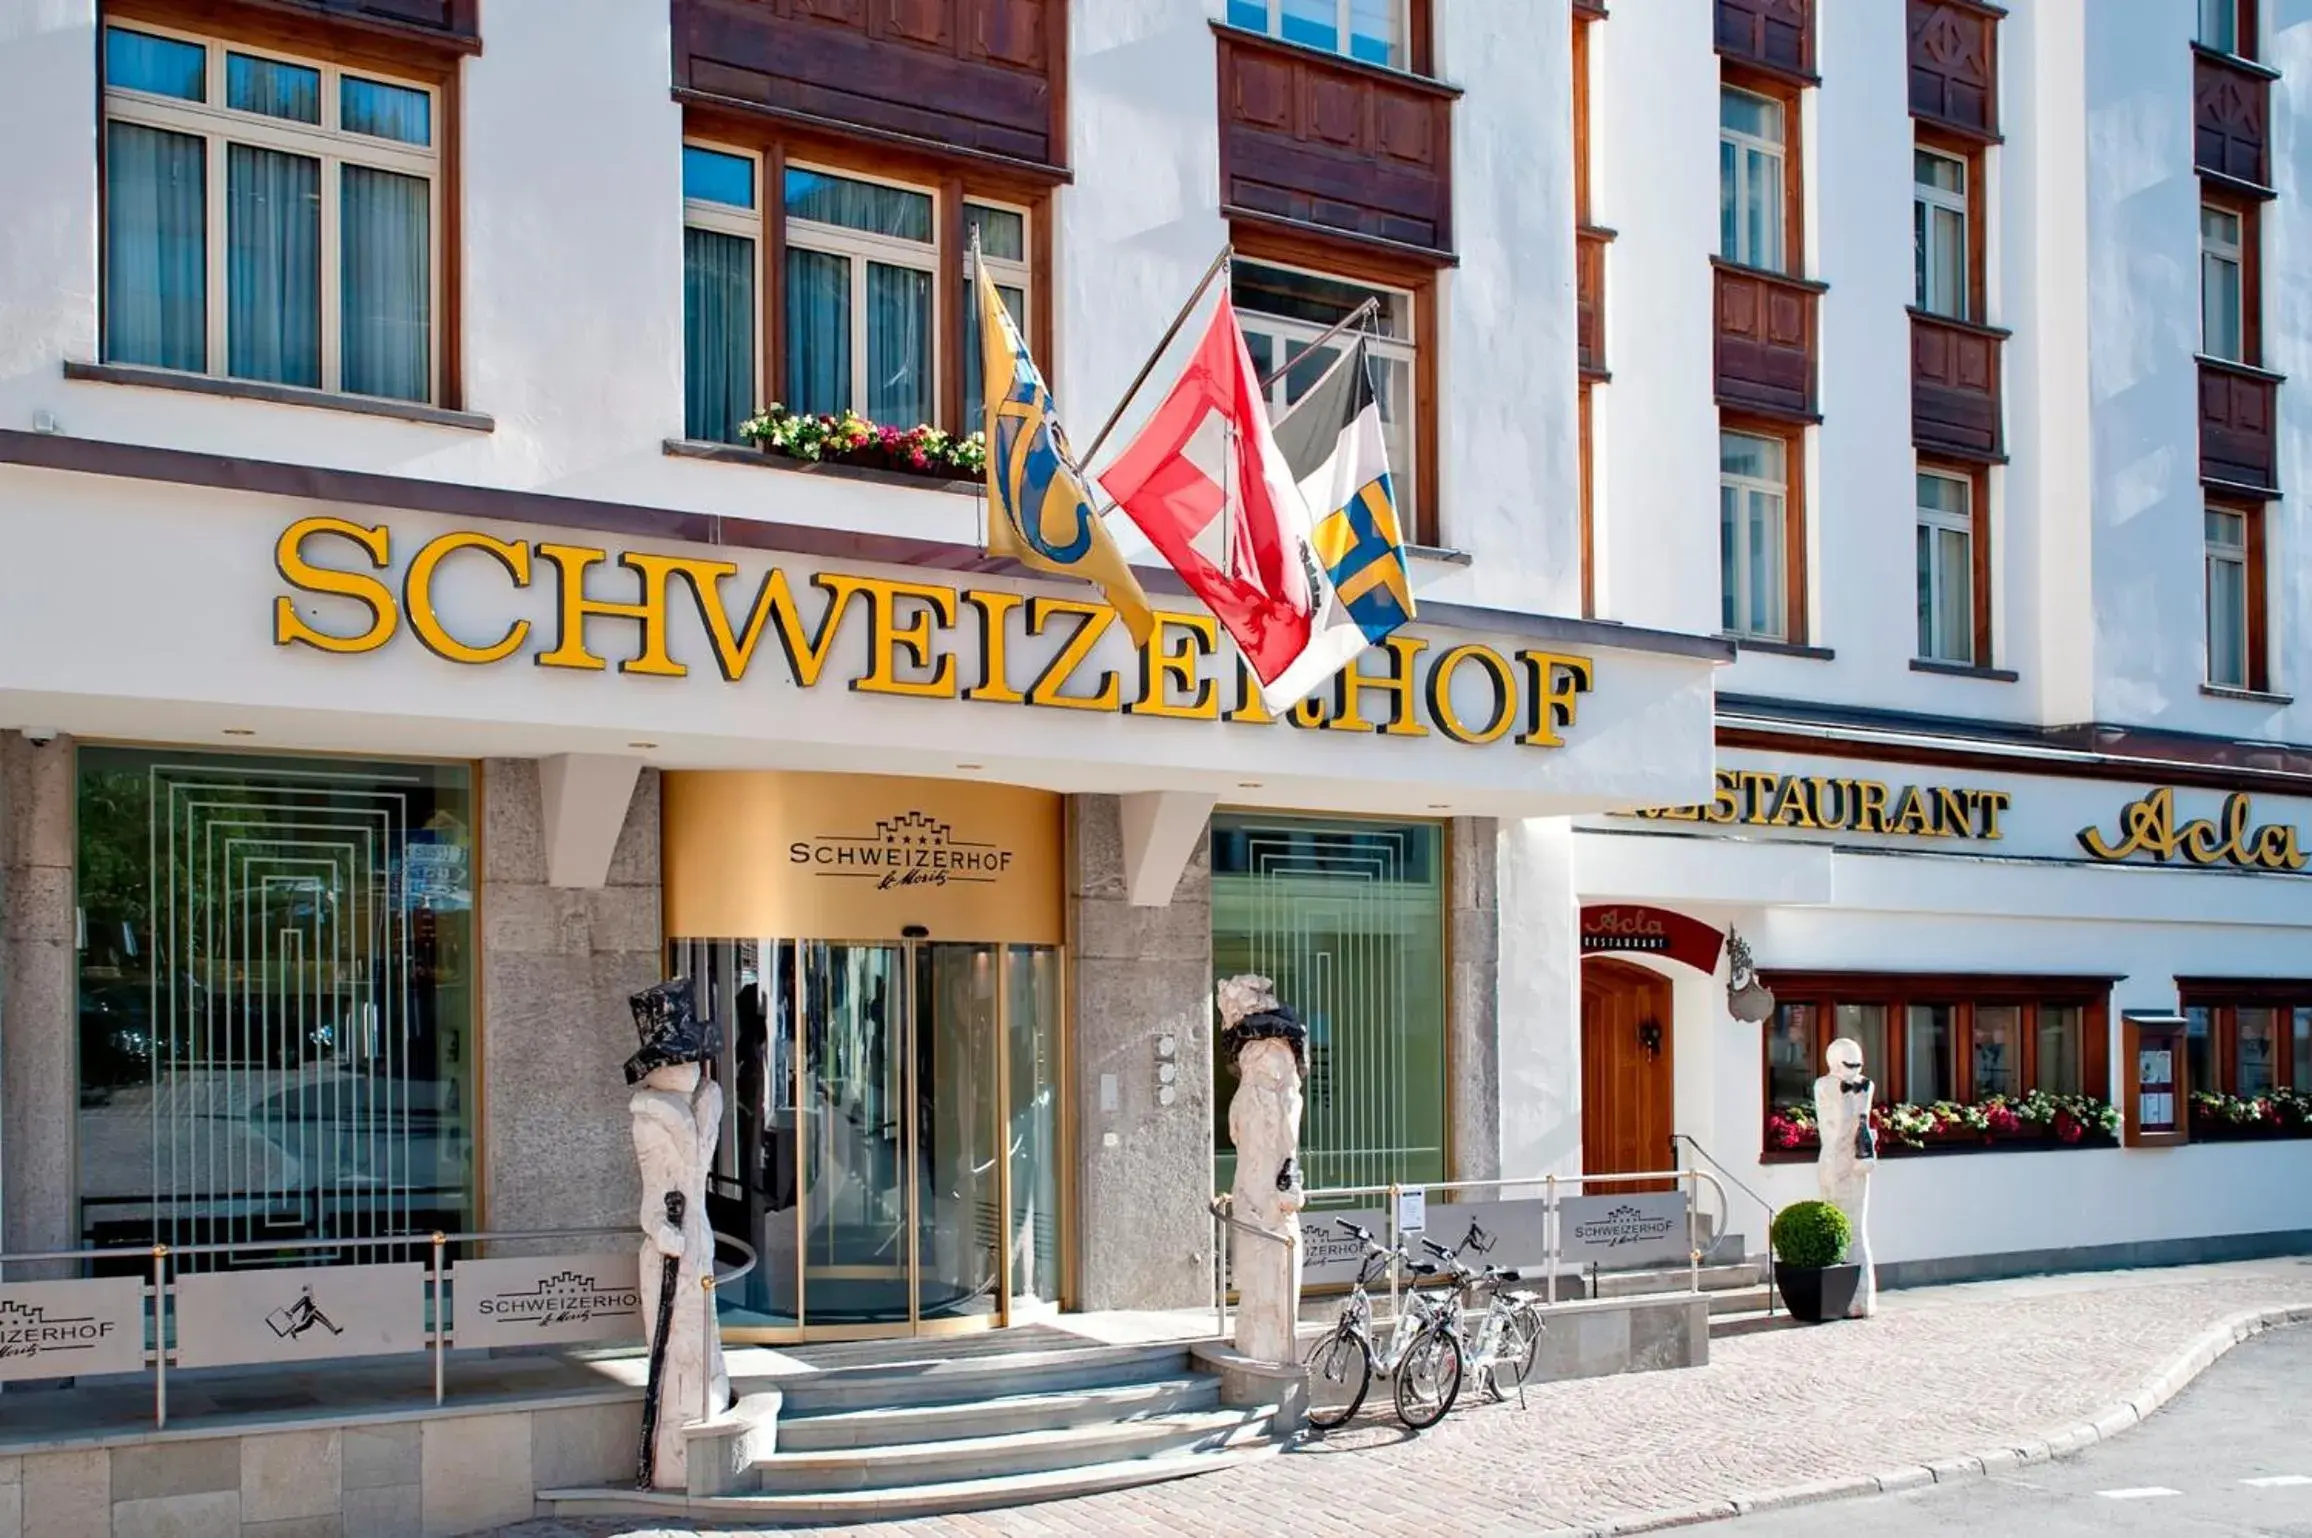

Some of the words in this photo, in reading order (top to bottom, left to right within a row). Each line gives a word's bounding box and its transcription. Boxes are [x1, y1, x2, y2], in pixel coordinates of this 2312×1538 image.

[1604, 770, 2011, 840] STAURANT
[2076, 786, 2312, 869] Acla
[789, 842, 1012, 872] SCHWEIZERHOF
[1584, 908, 1667, 934] Acla
[1574, 1219, 1674, 1239] SCHWEIZERHOF
[479, 1293, 643, 1315] SCHWEIZERHO
